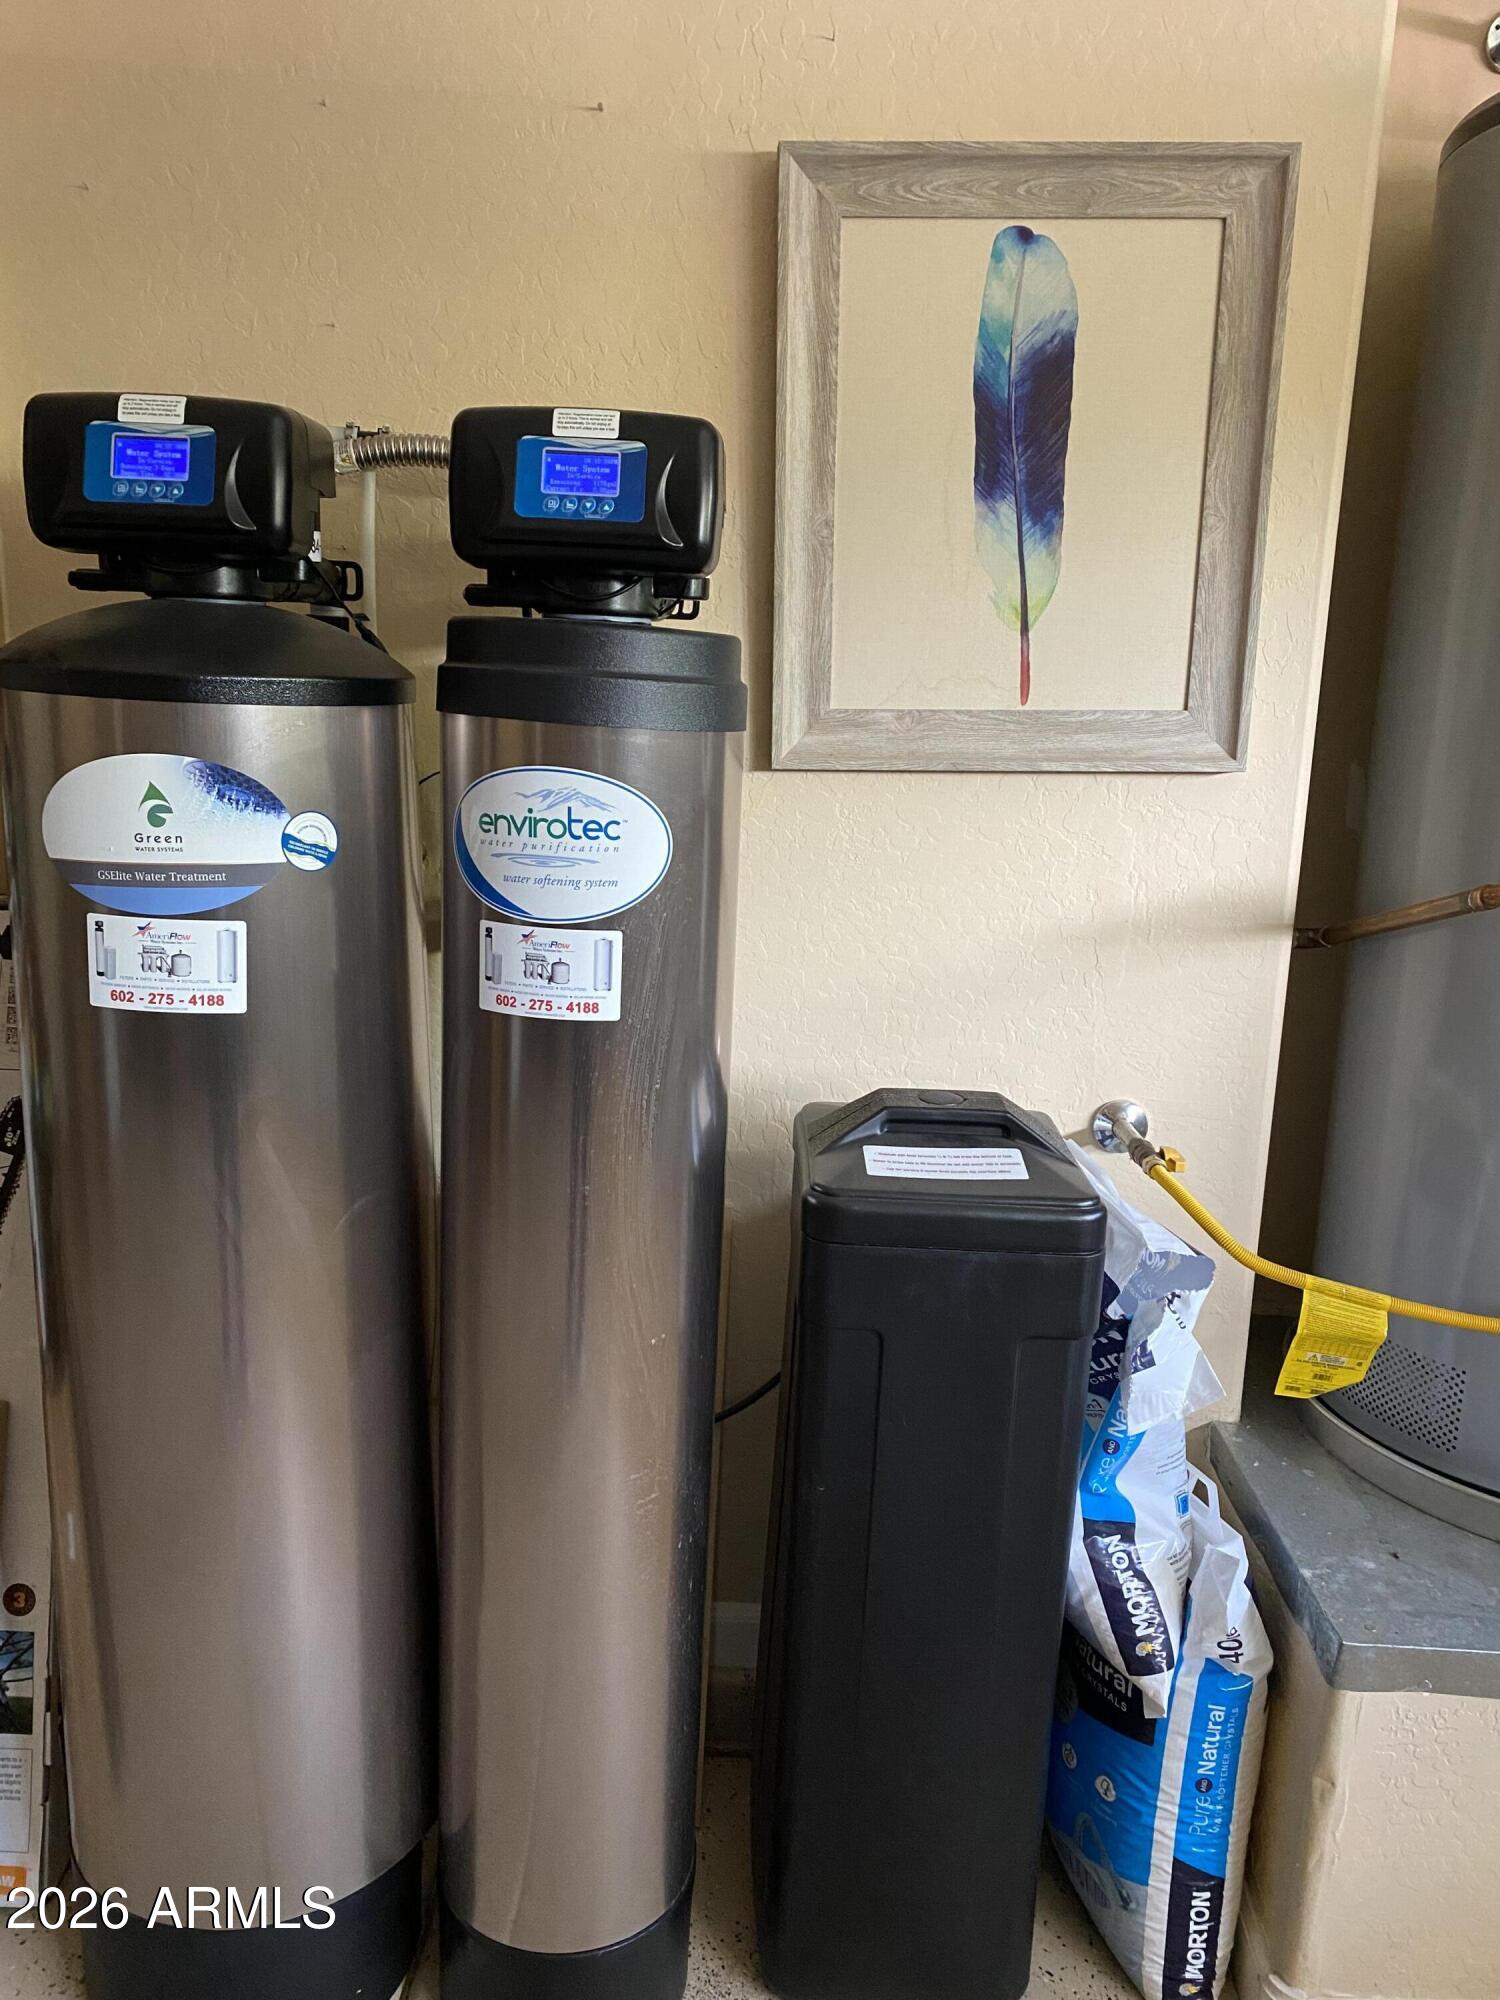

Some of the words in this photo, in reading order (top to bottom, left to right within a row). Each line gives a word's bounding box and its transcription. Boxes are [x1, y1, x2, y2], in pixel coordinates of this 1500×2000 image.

[478, 806, 621, 841] envirotec
[134, 833, 183, 844] Green
[480, 838, 514, 848] water
[521, 840, 620, 854] purification
[97, 870, 132, 881] GSElite
[134, 872, 166, 881] Water
[168, 872, 226, 882] Treatment
[502, 873, 531, 884] water
[533, 873, 581, 889] softening
[583, 877, 619, 889] system
[110, 989, 135, 1003] 602
[148, 992, 174, 1005] 275
[188, 994, 225, 1007] 4188
[496, 994, 517, 1008] 602
[529, 998, 553, 1012] 275
[565, 1001, 600, 1014] 4188
[14, 1591, 26, 1608] 3
[1076, 1640, 1133, 1698] atural
[1197, 1705, 1227, 1776] Natural
[1189, 1796, 1211, 1838] Pure
[1185, 1891, 1211, 1982] MORTON
